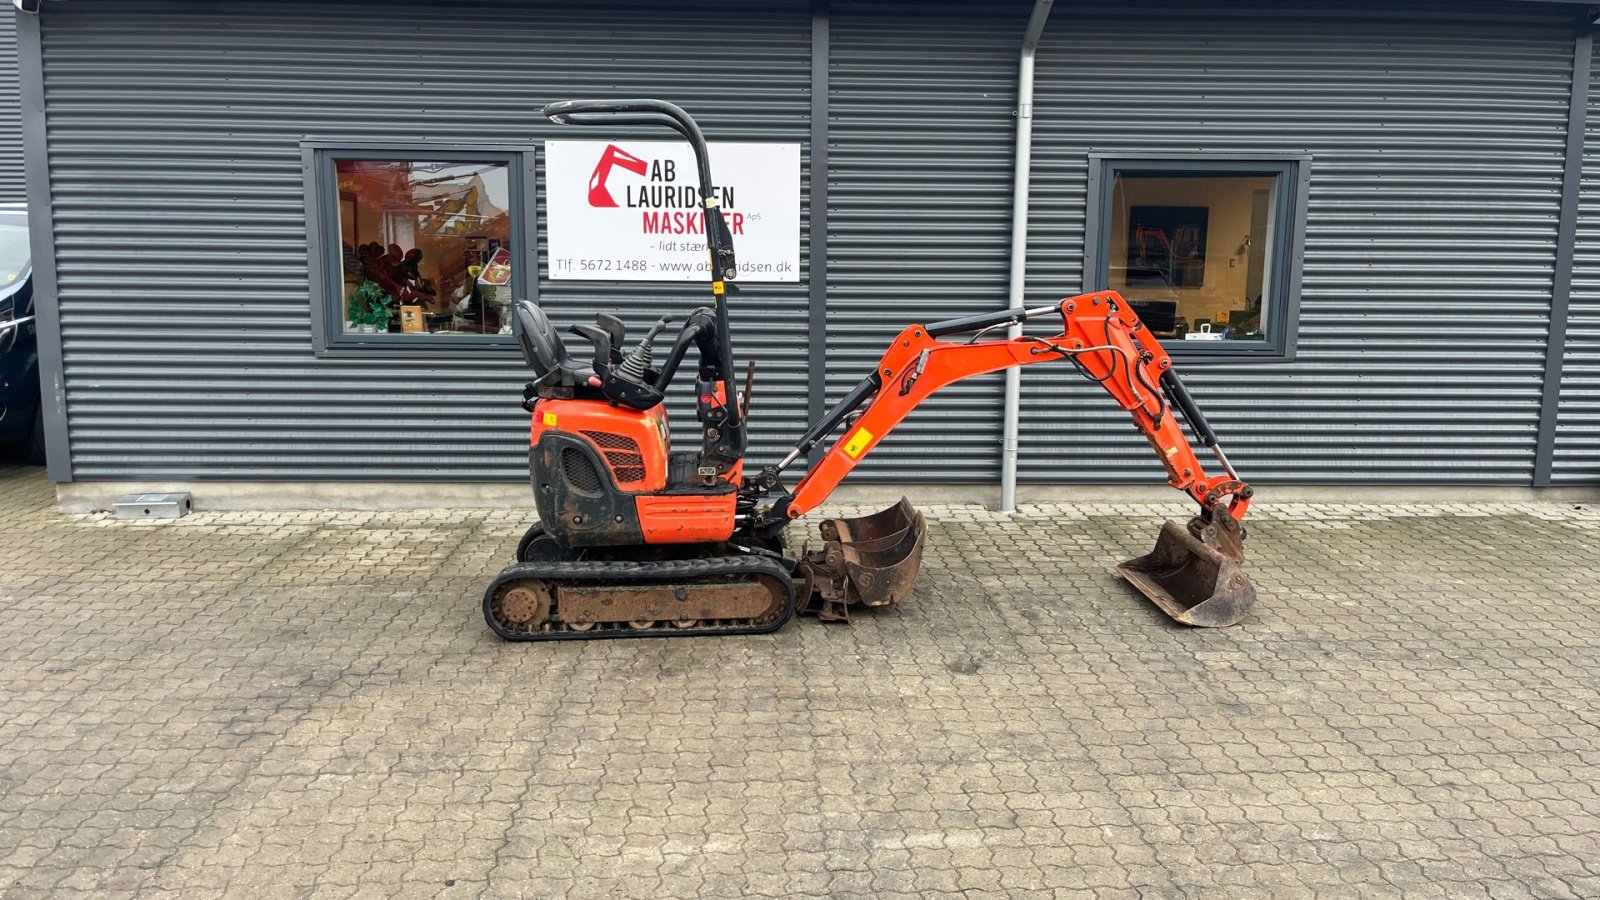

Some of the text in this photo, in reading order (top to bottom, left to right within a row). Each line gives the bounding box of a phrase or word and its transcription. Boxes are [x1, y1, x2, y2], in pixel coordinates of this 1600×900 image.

[651, 159, 676, 182] AB
[659, 241, 677, 252] lidt
[556, 258, 576, 273] Tlf.
[580, 259, 612, 271] 5672
[615, 259, 647, 271] 1488
